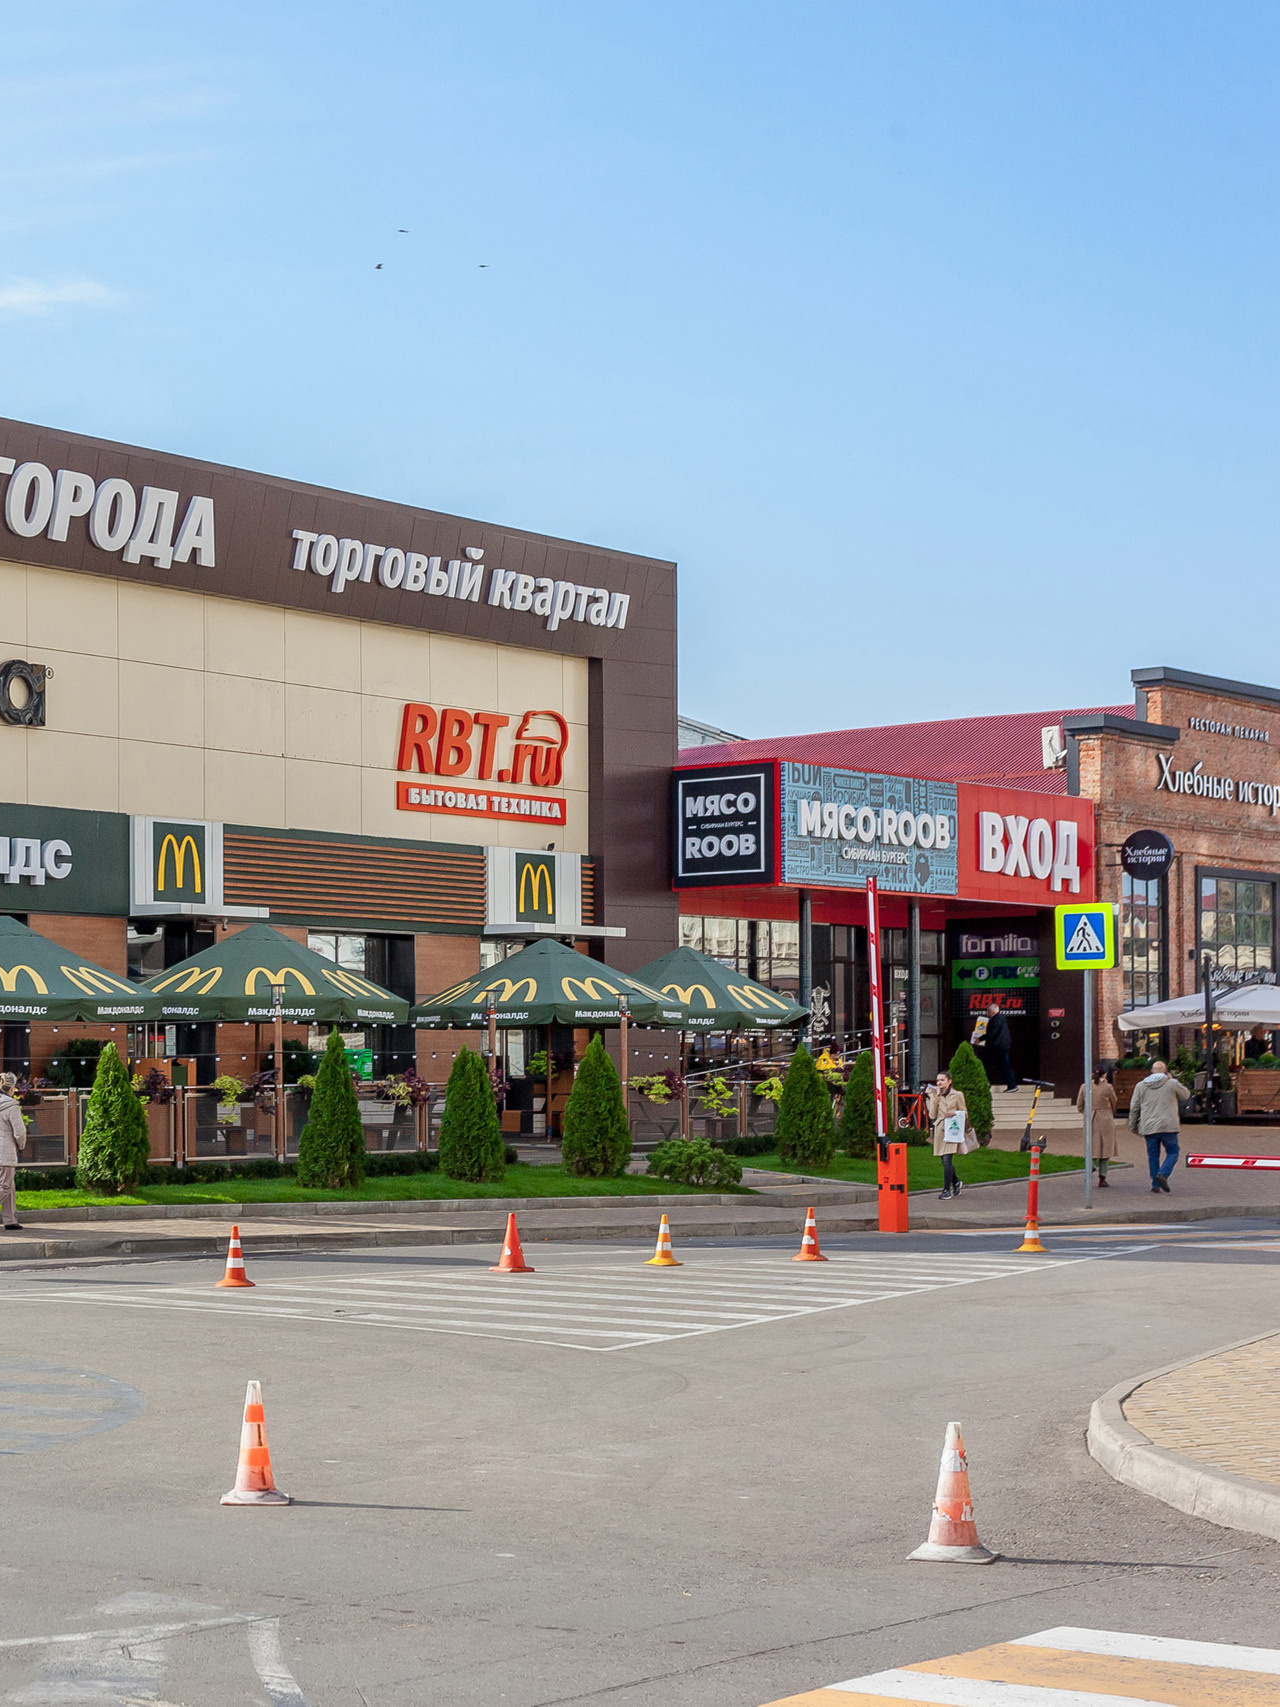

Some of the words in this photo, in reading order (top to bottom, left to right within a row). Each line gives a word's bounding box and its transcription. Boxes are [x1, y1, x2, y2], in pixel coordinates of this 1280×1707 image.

[292, 528, 485, 602] торговый
[488, 568, 631, 631] квартал
[1190, 717, 1232, 735] РЕСТОРАН
[1235, 727, 1270, 742] ПЕКАРНЯ
[397, 703, 563, 786] RBT.ru
[1157, 754, 1234, 800] Хлебные
[408, 787, 487, 811] БЫТОВАЯ
[491, 796, 561, 818] ТЕХНИКА
[686, 792, 756, 818] МЯСО
[798, 799, 876, 843] МЯСО
[881, 808, 951, 850] ROOB
[686, 833, 757, 859] ROOB
[842, 847, 880, 863] СИБИРИАН
[882, 850, 910, 865] БУРГЕРС
[978, 811, 1080, 893] ВХОД
[1125, 846, 1168, 858] Хлебные
[1127, 856, 1166, 865] истории
[962, 934, 1031, 953] familia
[97, 1005, 145, 1015] Макдоналдс
[248, 1007, 316, 1016] Макдналдс
[969, 993, 1024, 1009] RBT.ru
[1180, 1009, 1206, 1018] Хлебн
